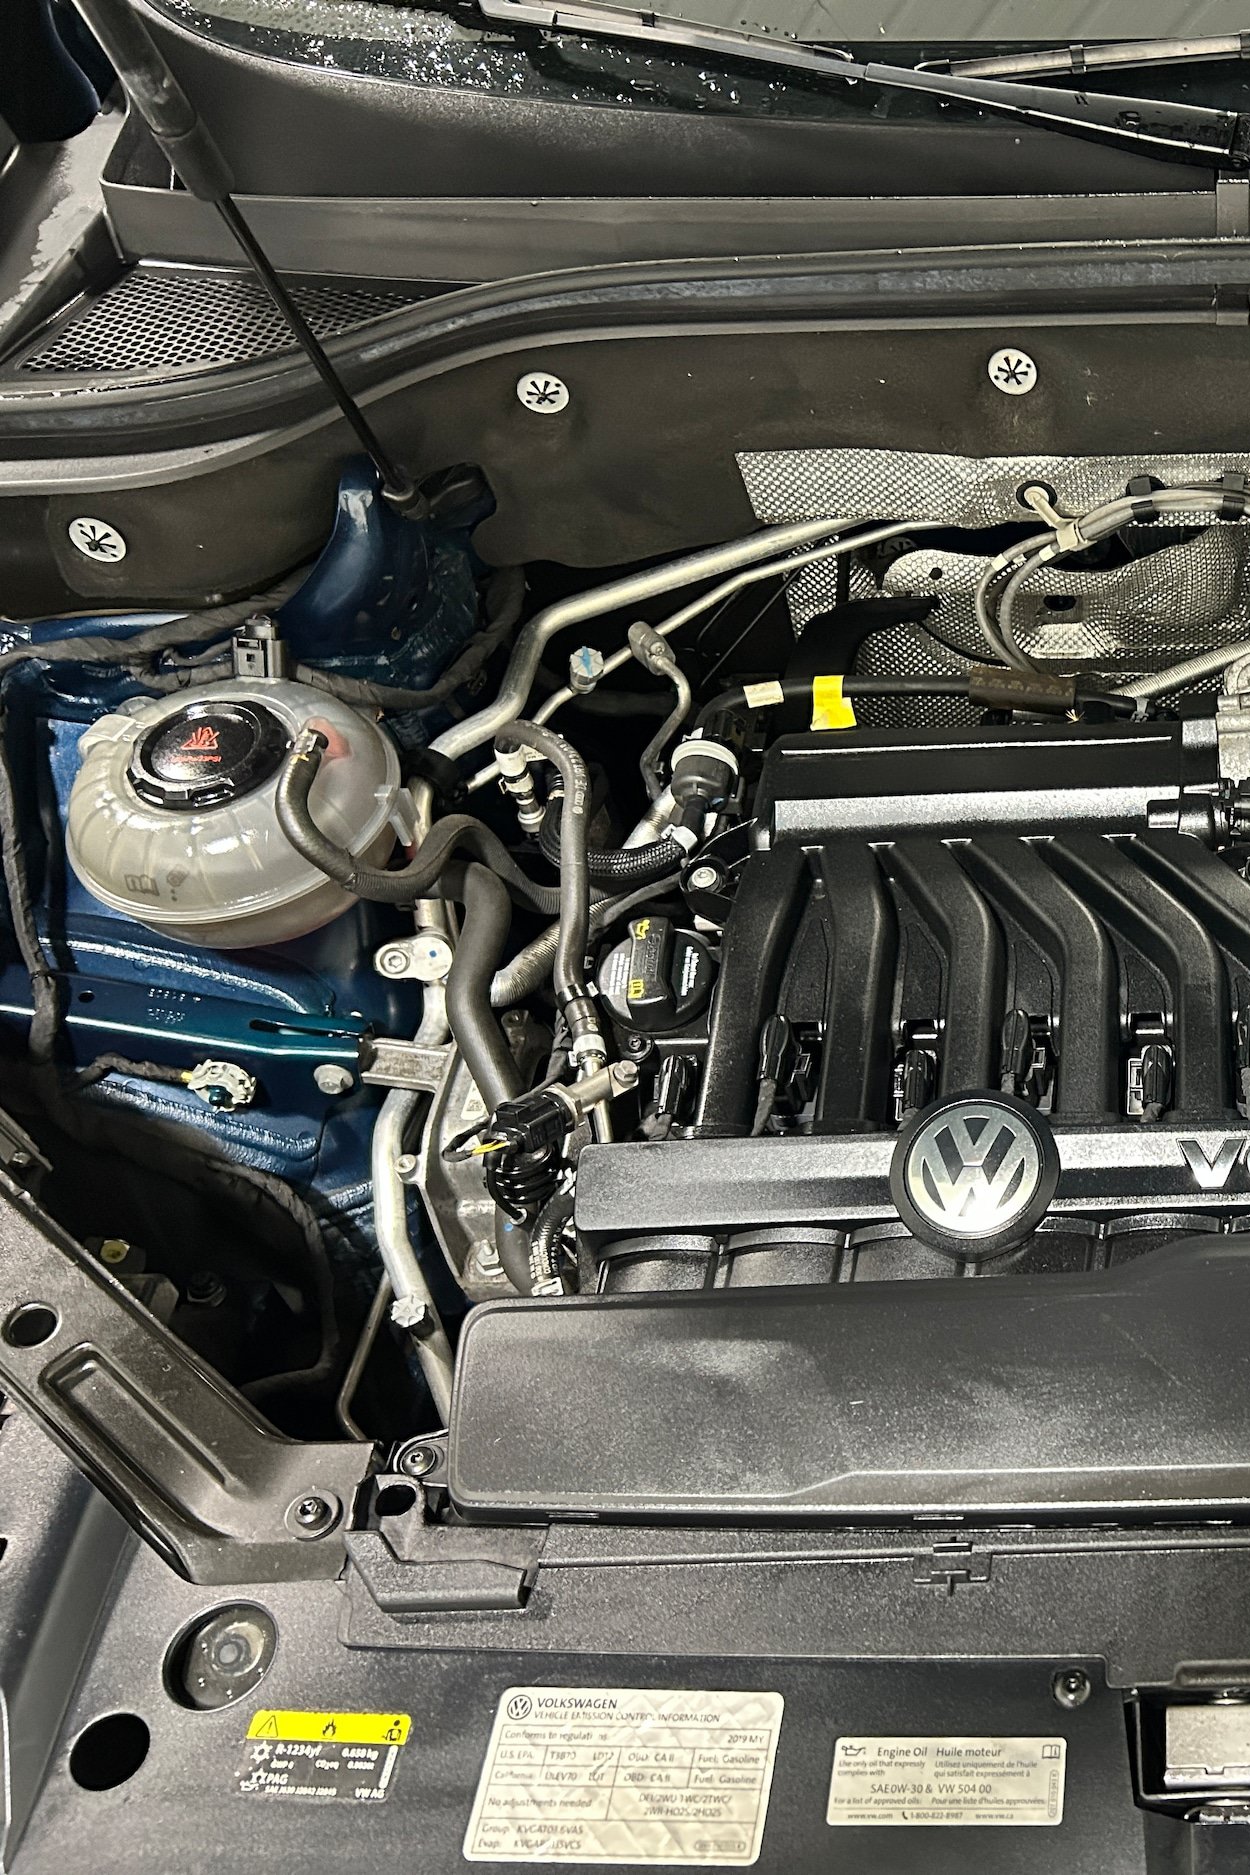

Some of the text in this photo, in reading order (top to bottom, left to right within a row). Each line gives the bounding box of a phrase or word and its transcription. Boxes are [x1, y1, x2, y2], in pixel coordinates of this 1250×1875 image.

[908, 1104, 1041, 1236] VW
[537, 1697, 618, 1709] VOLKSWAGEN
[534, 1711, 568, 1720] VEHICLE
[571, 1711, 613, 1720] EMISSION
[658, 1712, 721, 1723] INFORMATION
[877, 1747, 927, 1759] Engine Oil
[936, 1747, 1002, 1757] Huile moteur
[894, 1761, 925, 1769] expressly
[962, 1761, 1004, 1770] uniquement
[266, 1773, 288, 1785] PAG
[934, 1770, 946, 1778] qui
[925, 1784, 932, 1794] &
[938, 1784, 955, 1794] VW
[958, 1784, 976, 1794] 504
[979, 1784, 992, 1794] 00
[873, 1797, 906, 1805] approved
